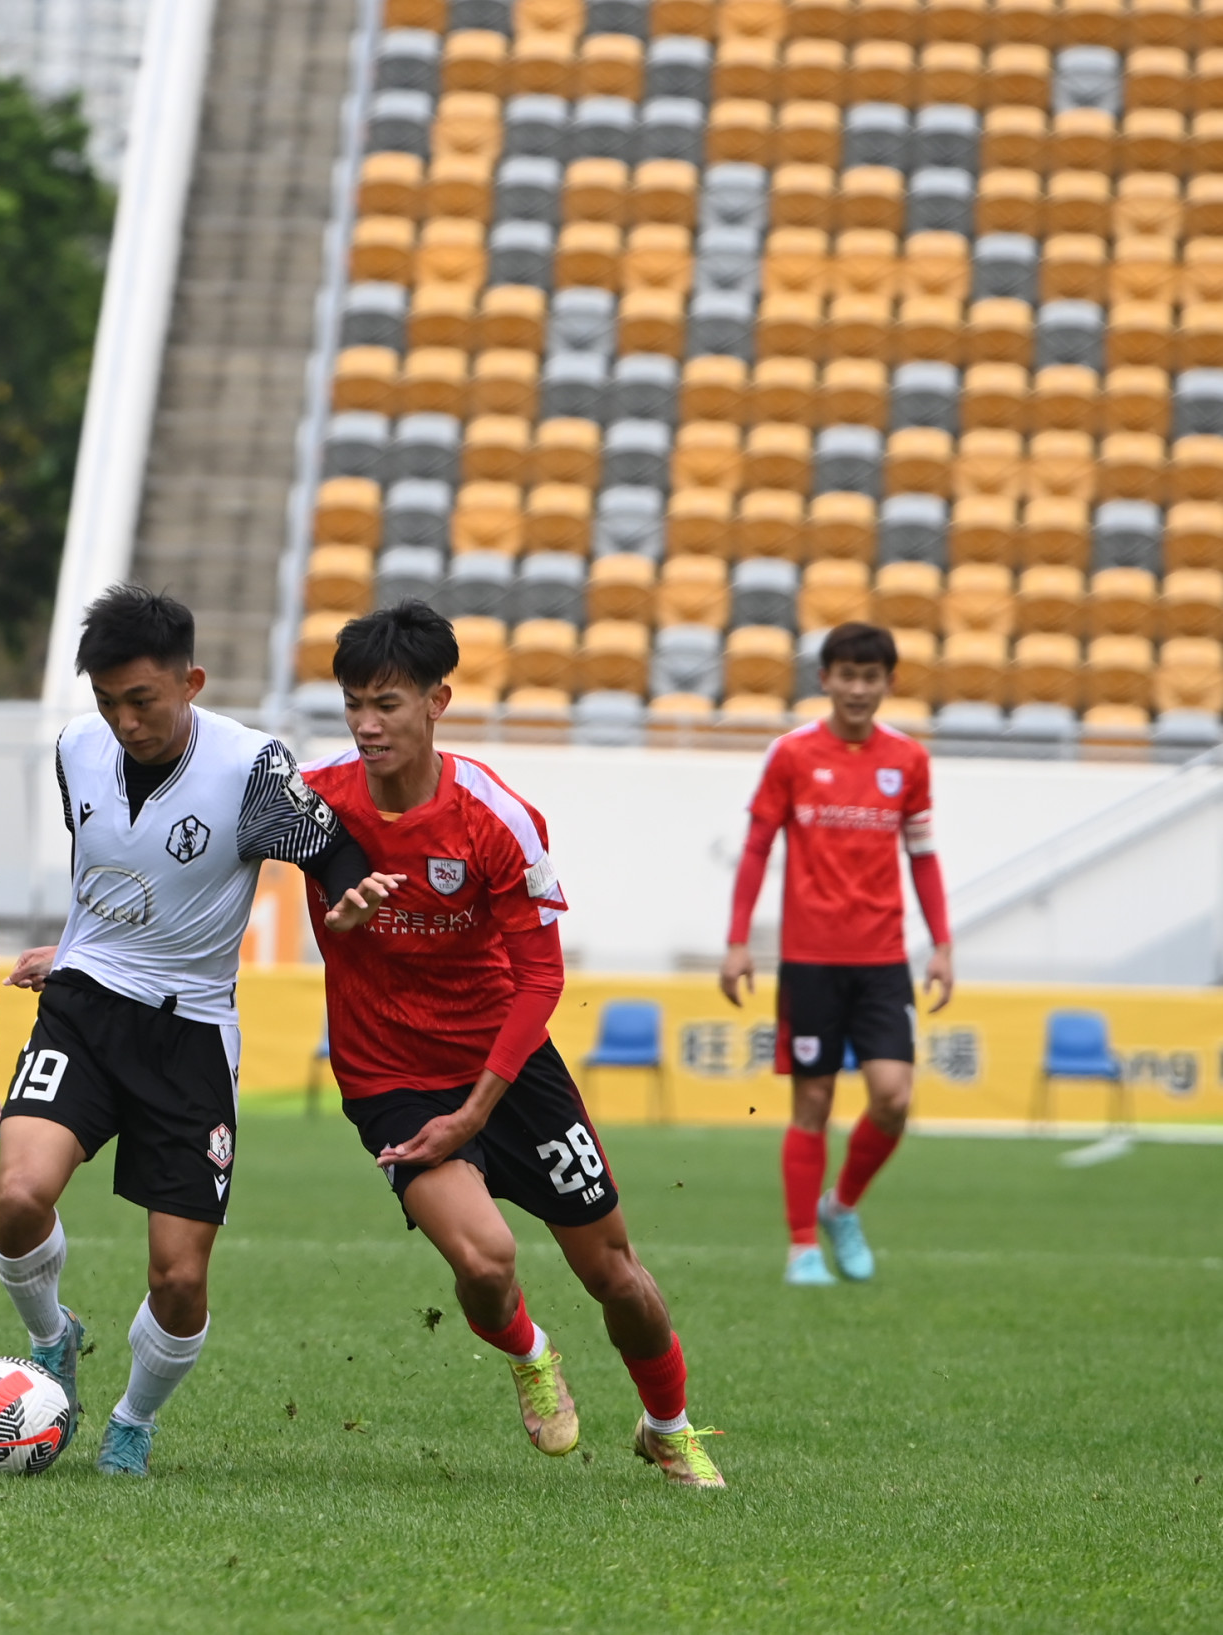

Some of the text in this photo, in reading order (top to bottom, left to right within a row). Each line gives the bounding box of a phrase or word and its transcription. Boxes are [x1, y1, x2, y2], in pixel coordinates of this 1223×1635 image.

[433, 903, 475, 926] SKY
[9, 1048, 69, 1102] 19
[536, 1121, 604, 1195] 28
